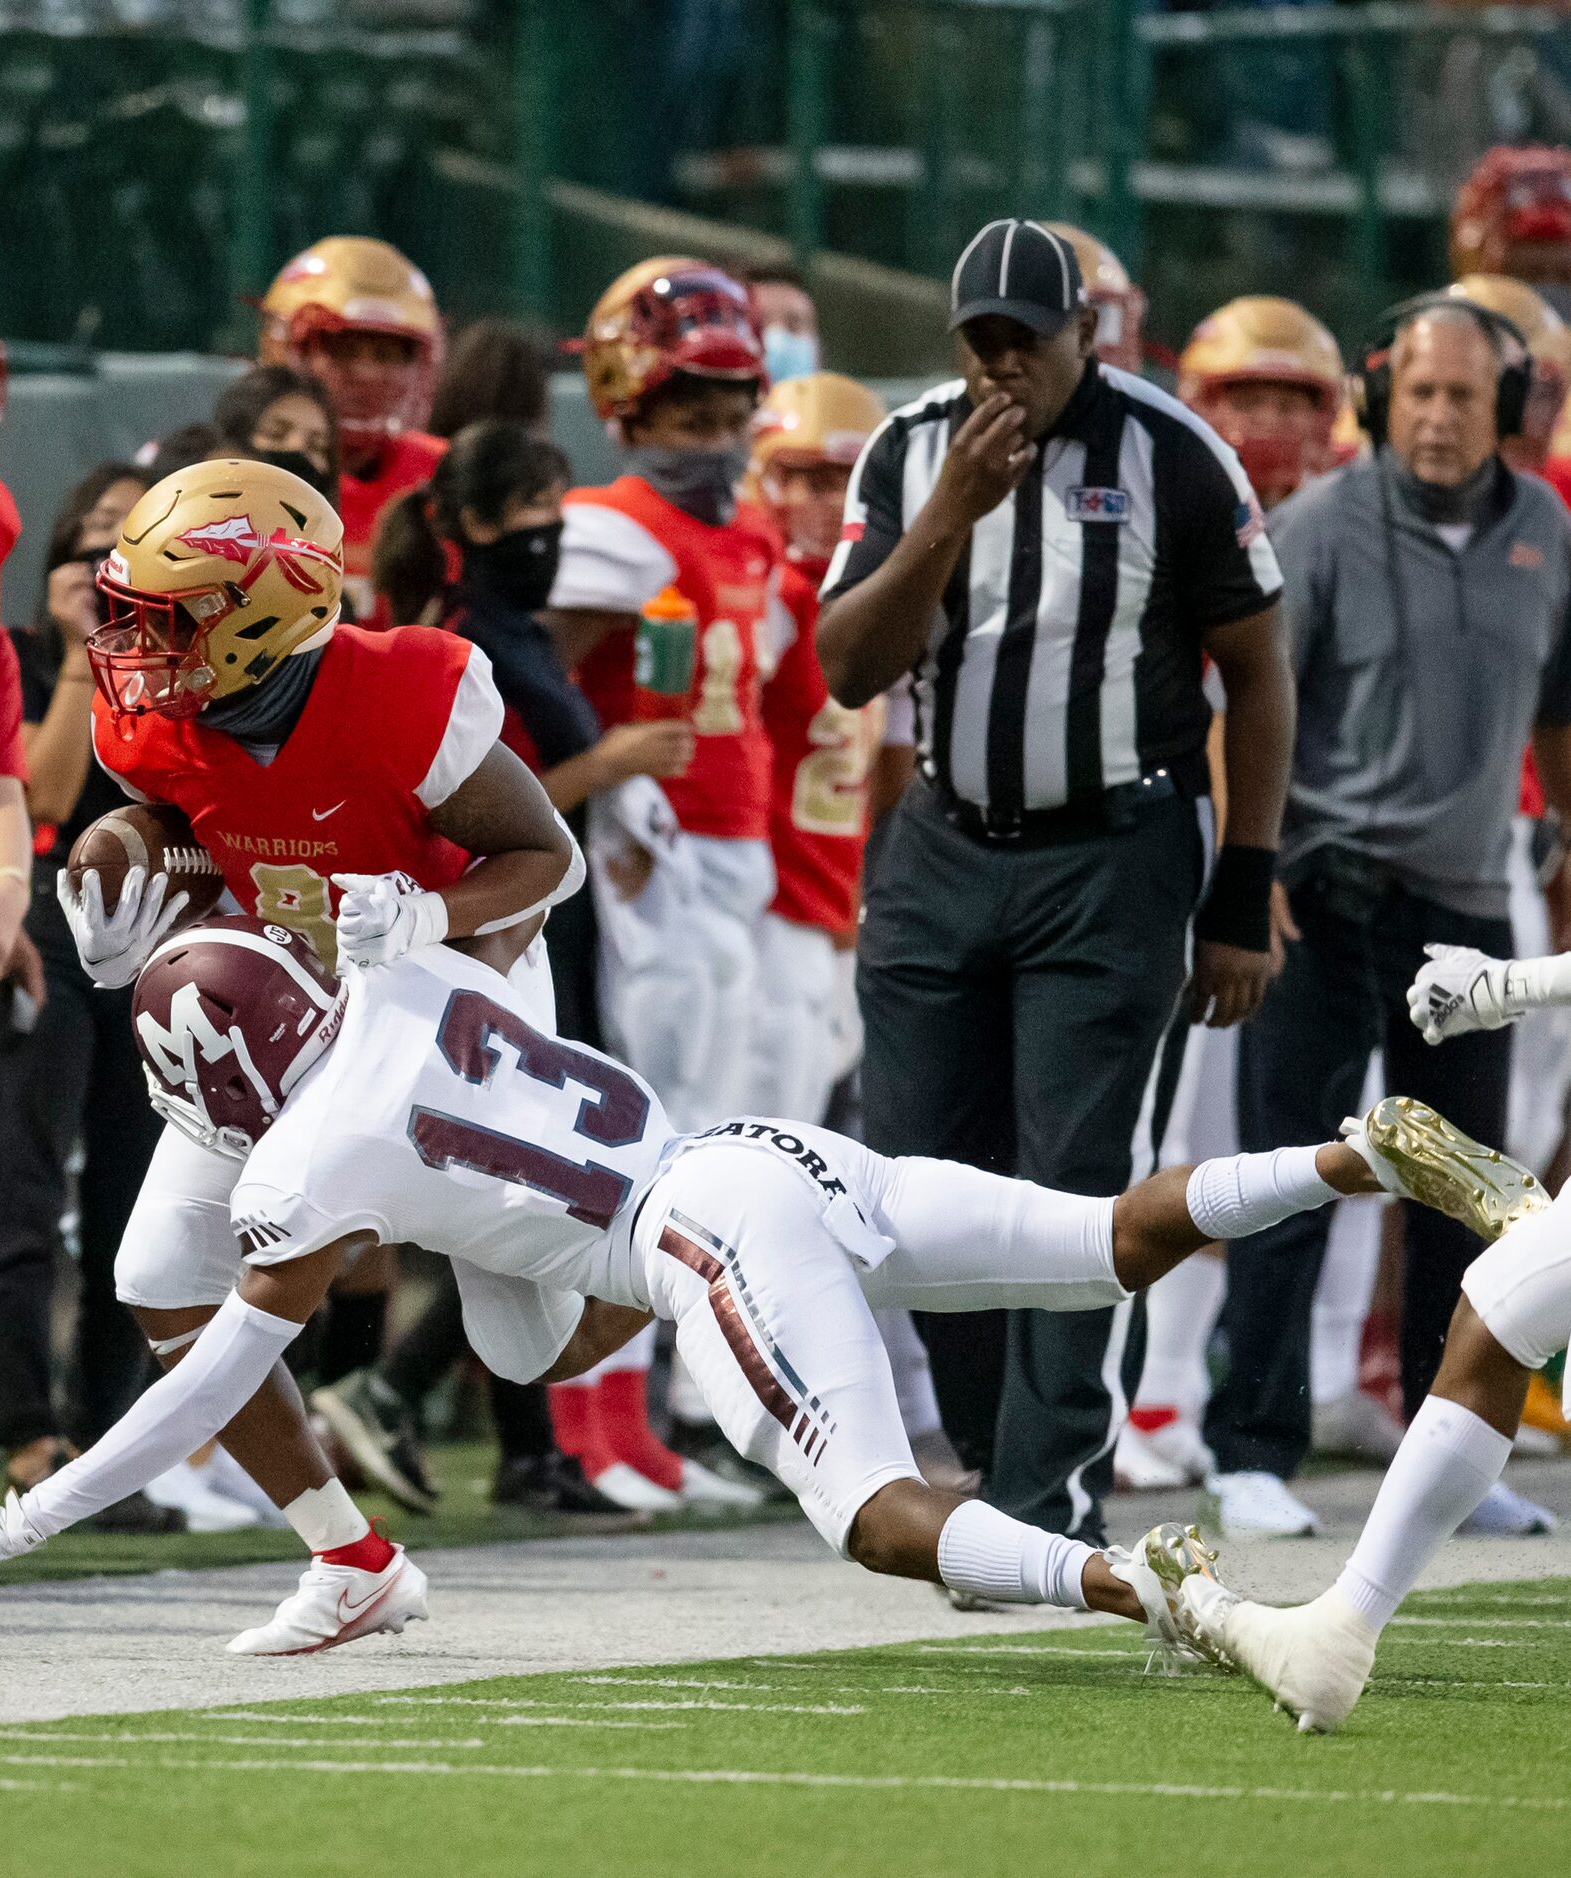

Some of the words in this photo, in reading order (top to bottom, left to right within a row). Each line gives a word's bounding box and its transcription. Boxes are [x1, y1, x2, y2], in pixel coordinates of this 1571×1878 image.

[217, 830, 339, 858] WARRIORS
[269, 925, 288, 943] JE
[136, 981, 234, 1087] M
[406, 987, 651, 1232] 13
